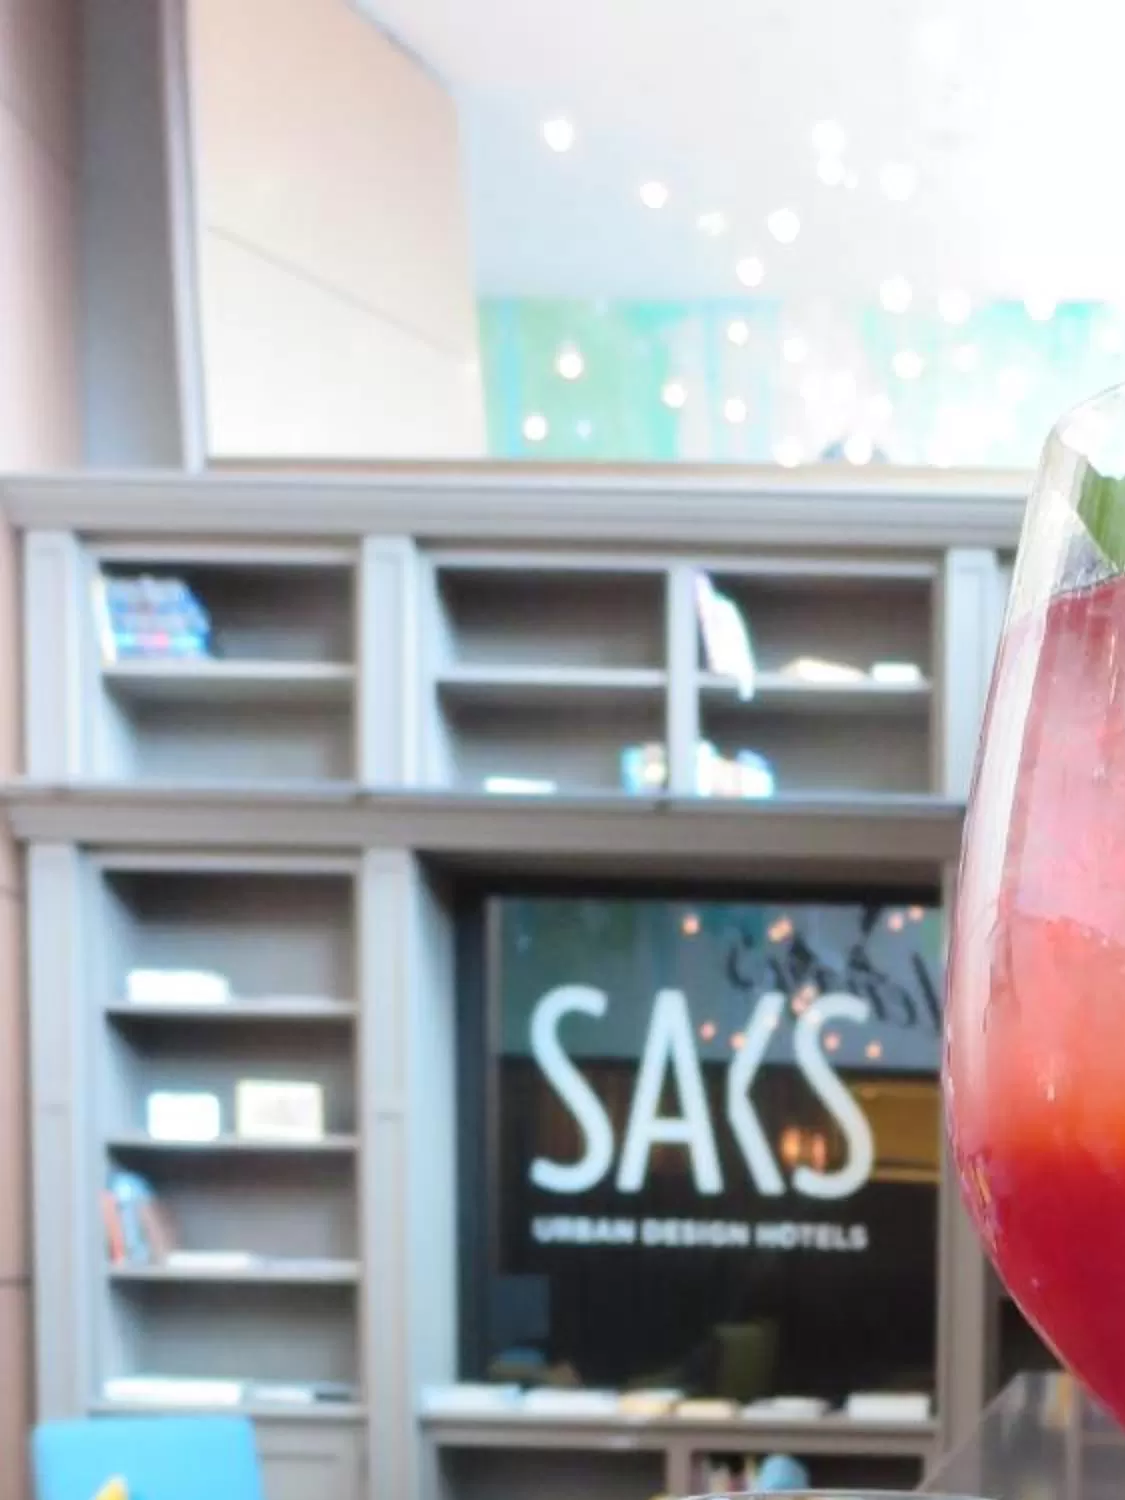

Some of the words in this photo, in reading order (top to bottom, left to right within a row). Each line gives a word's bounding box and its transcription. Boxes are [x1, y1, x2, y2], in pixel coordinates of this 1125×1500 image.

[531, 985, 872, 1199] SAKS
[531, 1216, 636, 1244] URBAN
[641, 1218, 749, 1246] DESIGN
[756, 1221, 869, 1251] HOTELS
